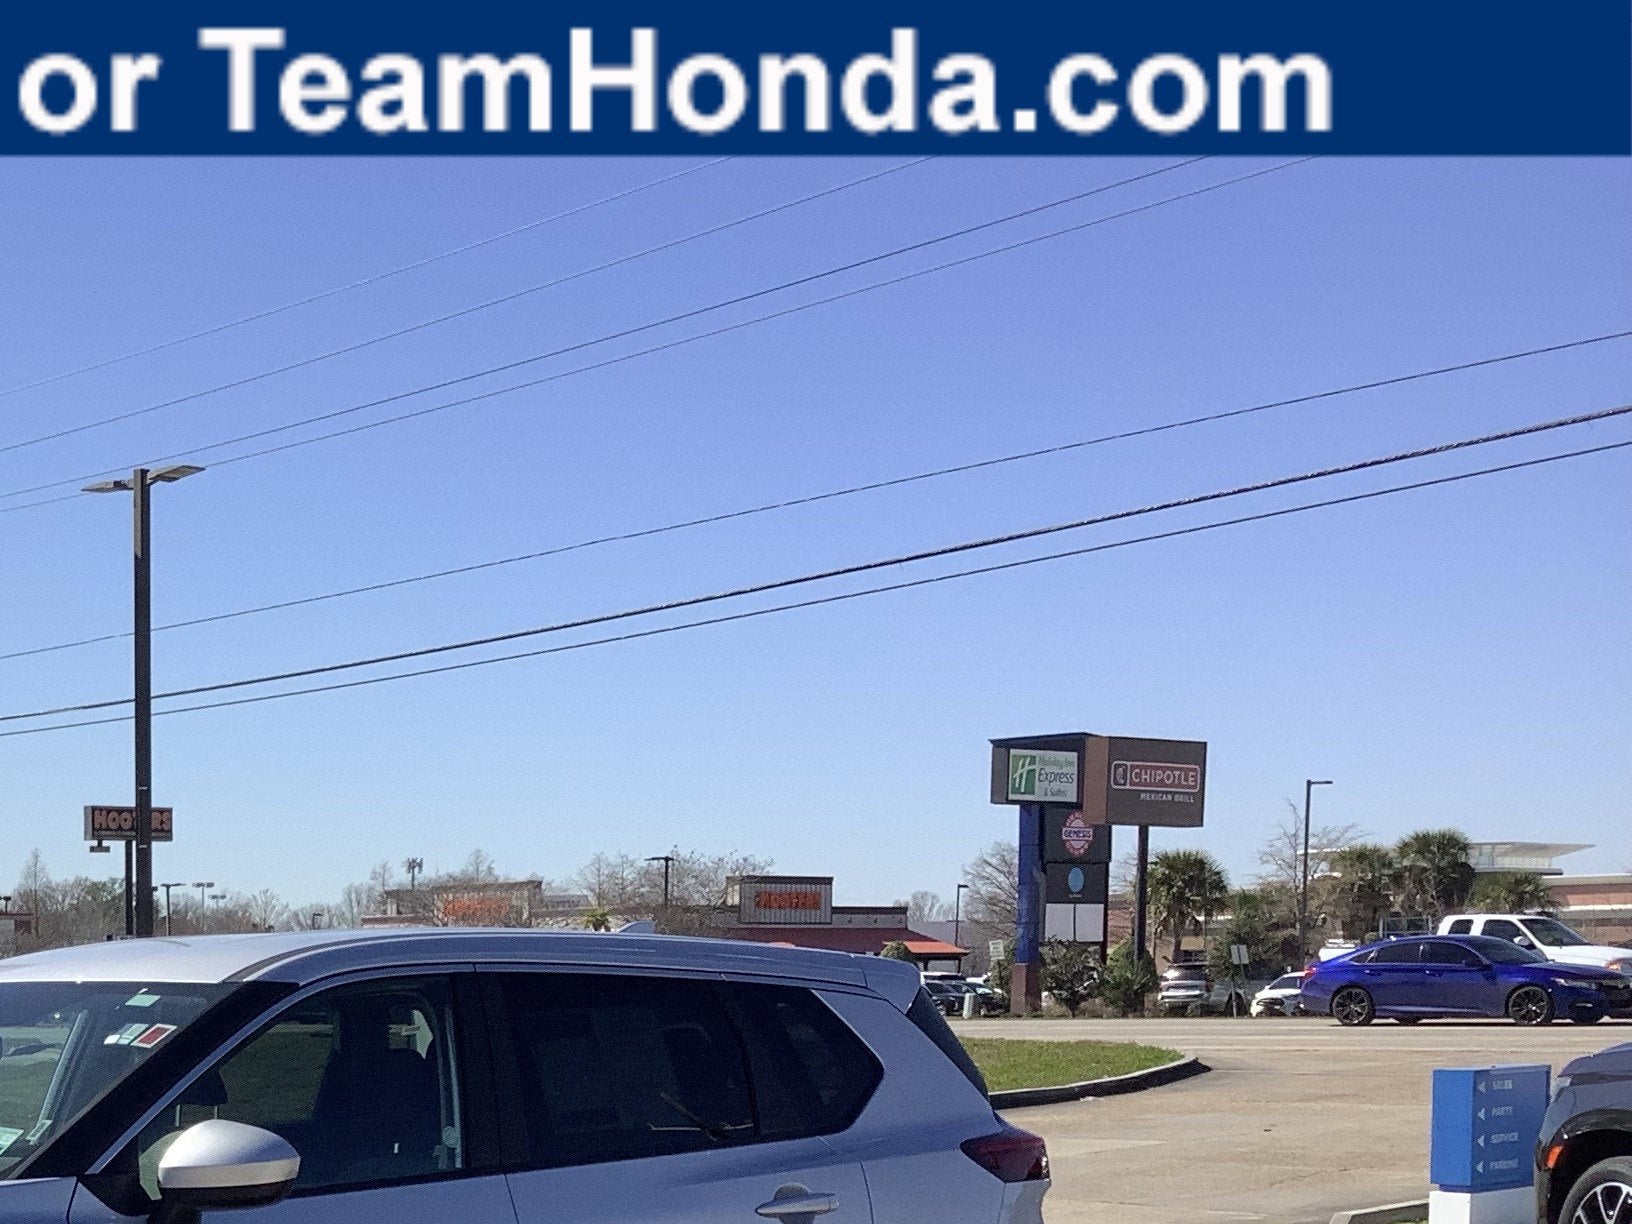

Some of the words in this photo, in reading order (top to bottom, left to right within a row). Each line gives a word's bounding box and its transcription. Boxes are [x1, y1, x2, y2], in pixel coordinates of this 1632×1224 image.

[1038, 768, 1075, 786] Express
[1132, 769, 1196, 785] CHIPOTLE
[1141, 793, 1172, 801] MEXICAN
[93, 809, 171, 831] HOORS
